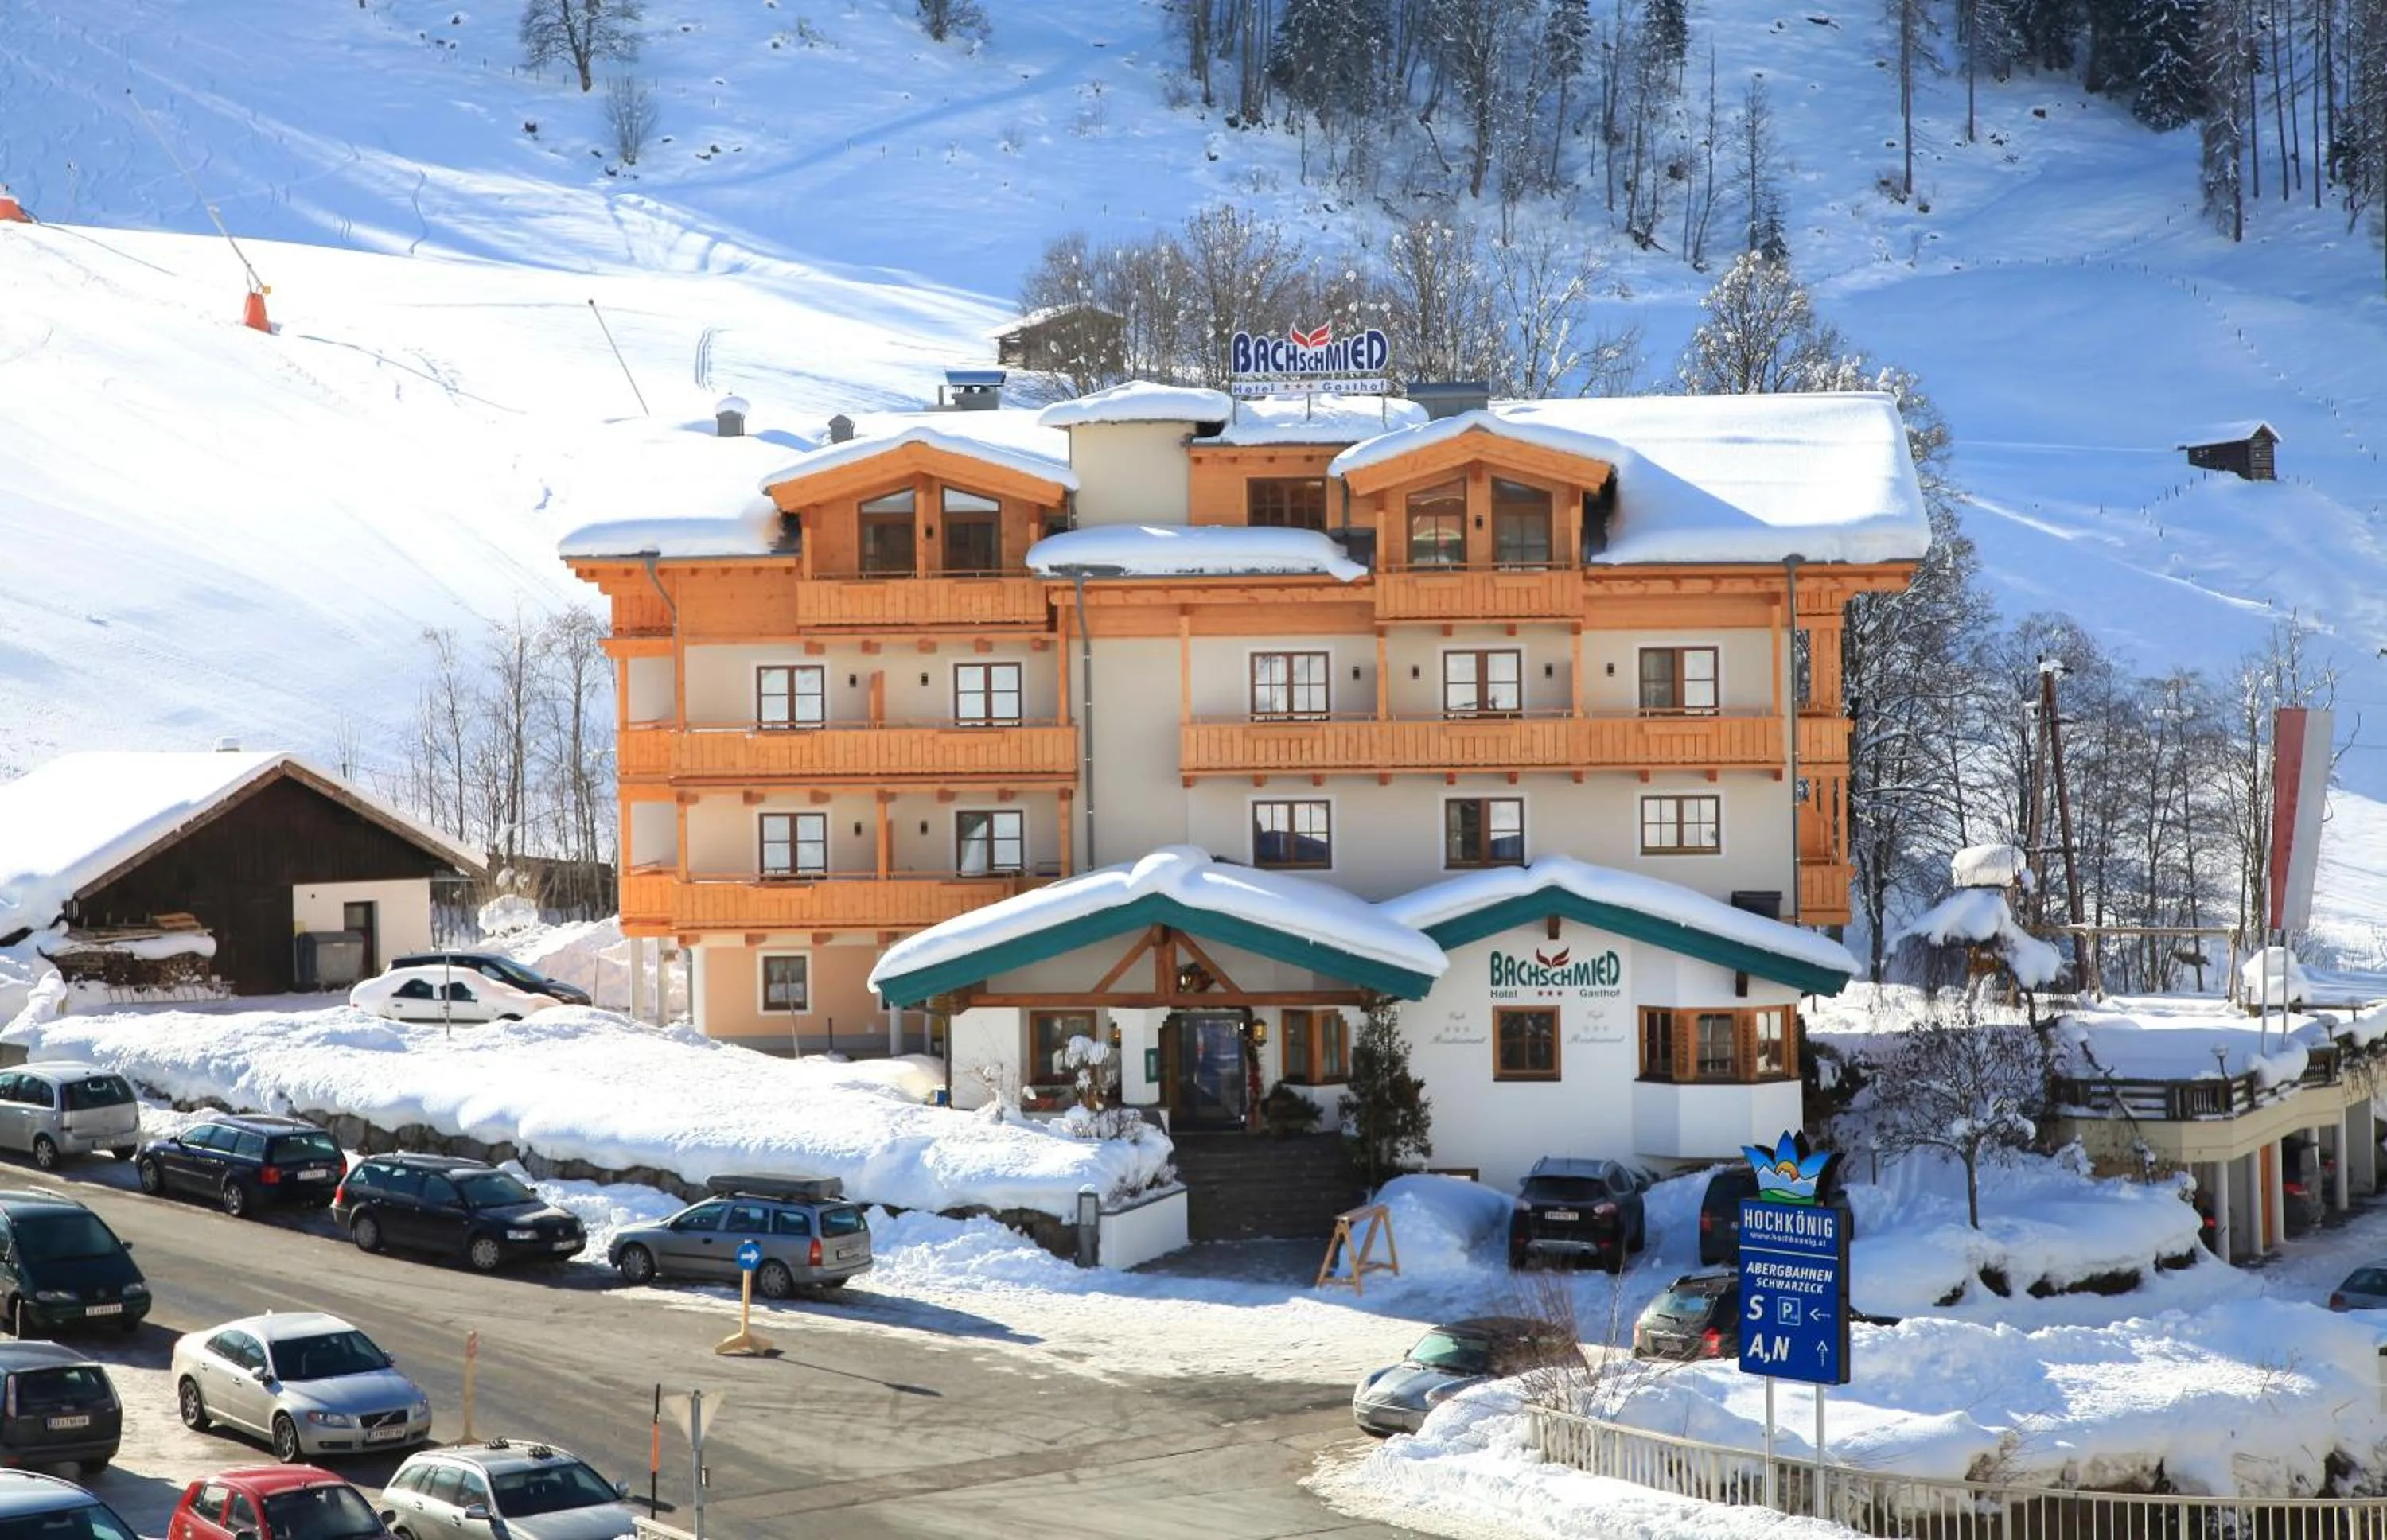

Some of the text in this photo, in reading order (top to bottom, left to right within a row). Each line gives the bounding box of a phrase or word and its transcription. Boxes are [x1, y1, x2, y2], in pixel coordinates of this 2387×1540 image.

[1232, 329, 1388, 373] BACHSCHMIED
[1233, 380, 1385, 394] Hotel Gasthof
[1490, 951, 1620, 986] BACHSCHMIED
[1490, 989, 1621, 998] Hotel Gasthof
[1743, 1208, 1832, 1239] HOCHKÖNIG
[1746, 1262, 1833, 1282] ABERGBAHNEN
[1755, 1277, 1824, 1294] SCHWARZECK
[1746, 1294, 1764, 1320] S
